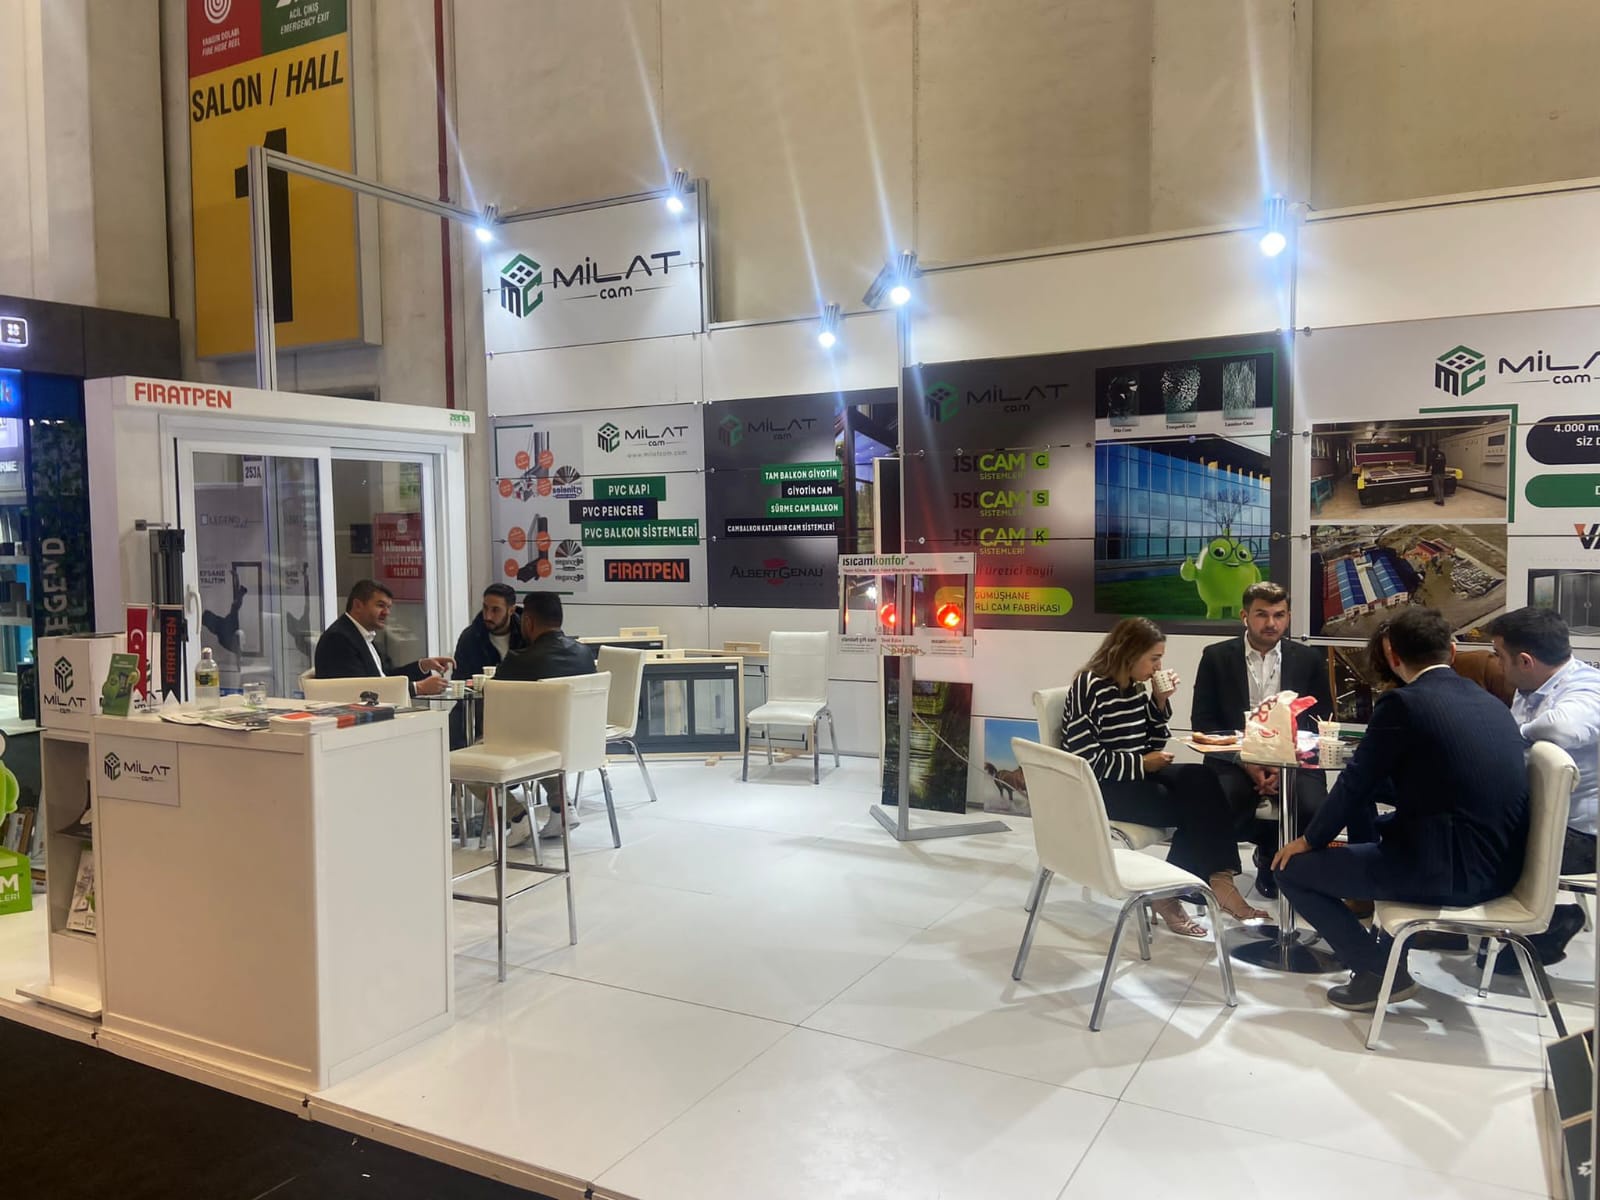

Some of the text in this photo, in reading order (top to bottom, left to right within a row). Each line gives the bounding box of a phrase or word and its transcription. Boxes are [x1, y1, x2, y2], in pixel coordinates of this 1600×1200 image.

[280, 11, 330, 35] EMERGENCY EXIT
[192, 72, 262, 123] SALON
[286, 50, 344, 97] HALL
[599, 285, 633, 299] cam
[1552, 373, 1591, 384] cam
[134, 382, 232, 409] FIRATPEN
[1003, 404, 1031, 413] cam
[1554, 423, 1585, 433] 4.000
[765, 468, 837, 480] TAM BALKON GİYOTİN
[608, 483, 650, 495] PVC KAPI
[787, 485, 833, 495] GİYOTİN CAM
[582, 505, 644, 517] PVC PENCERE
[770, 503, 838, 512] SÜRME CAM BALKON
[584, 523, 697, 538] PVC BALKON SİSTEMLERİ
[607, 562, 685, 579] FIRATPEN
[991, 603, 1010, 611] CAM
[1013, 602, 1060, 611] FABRİKASI
